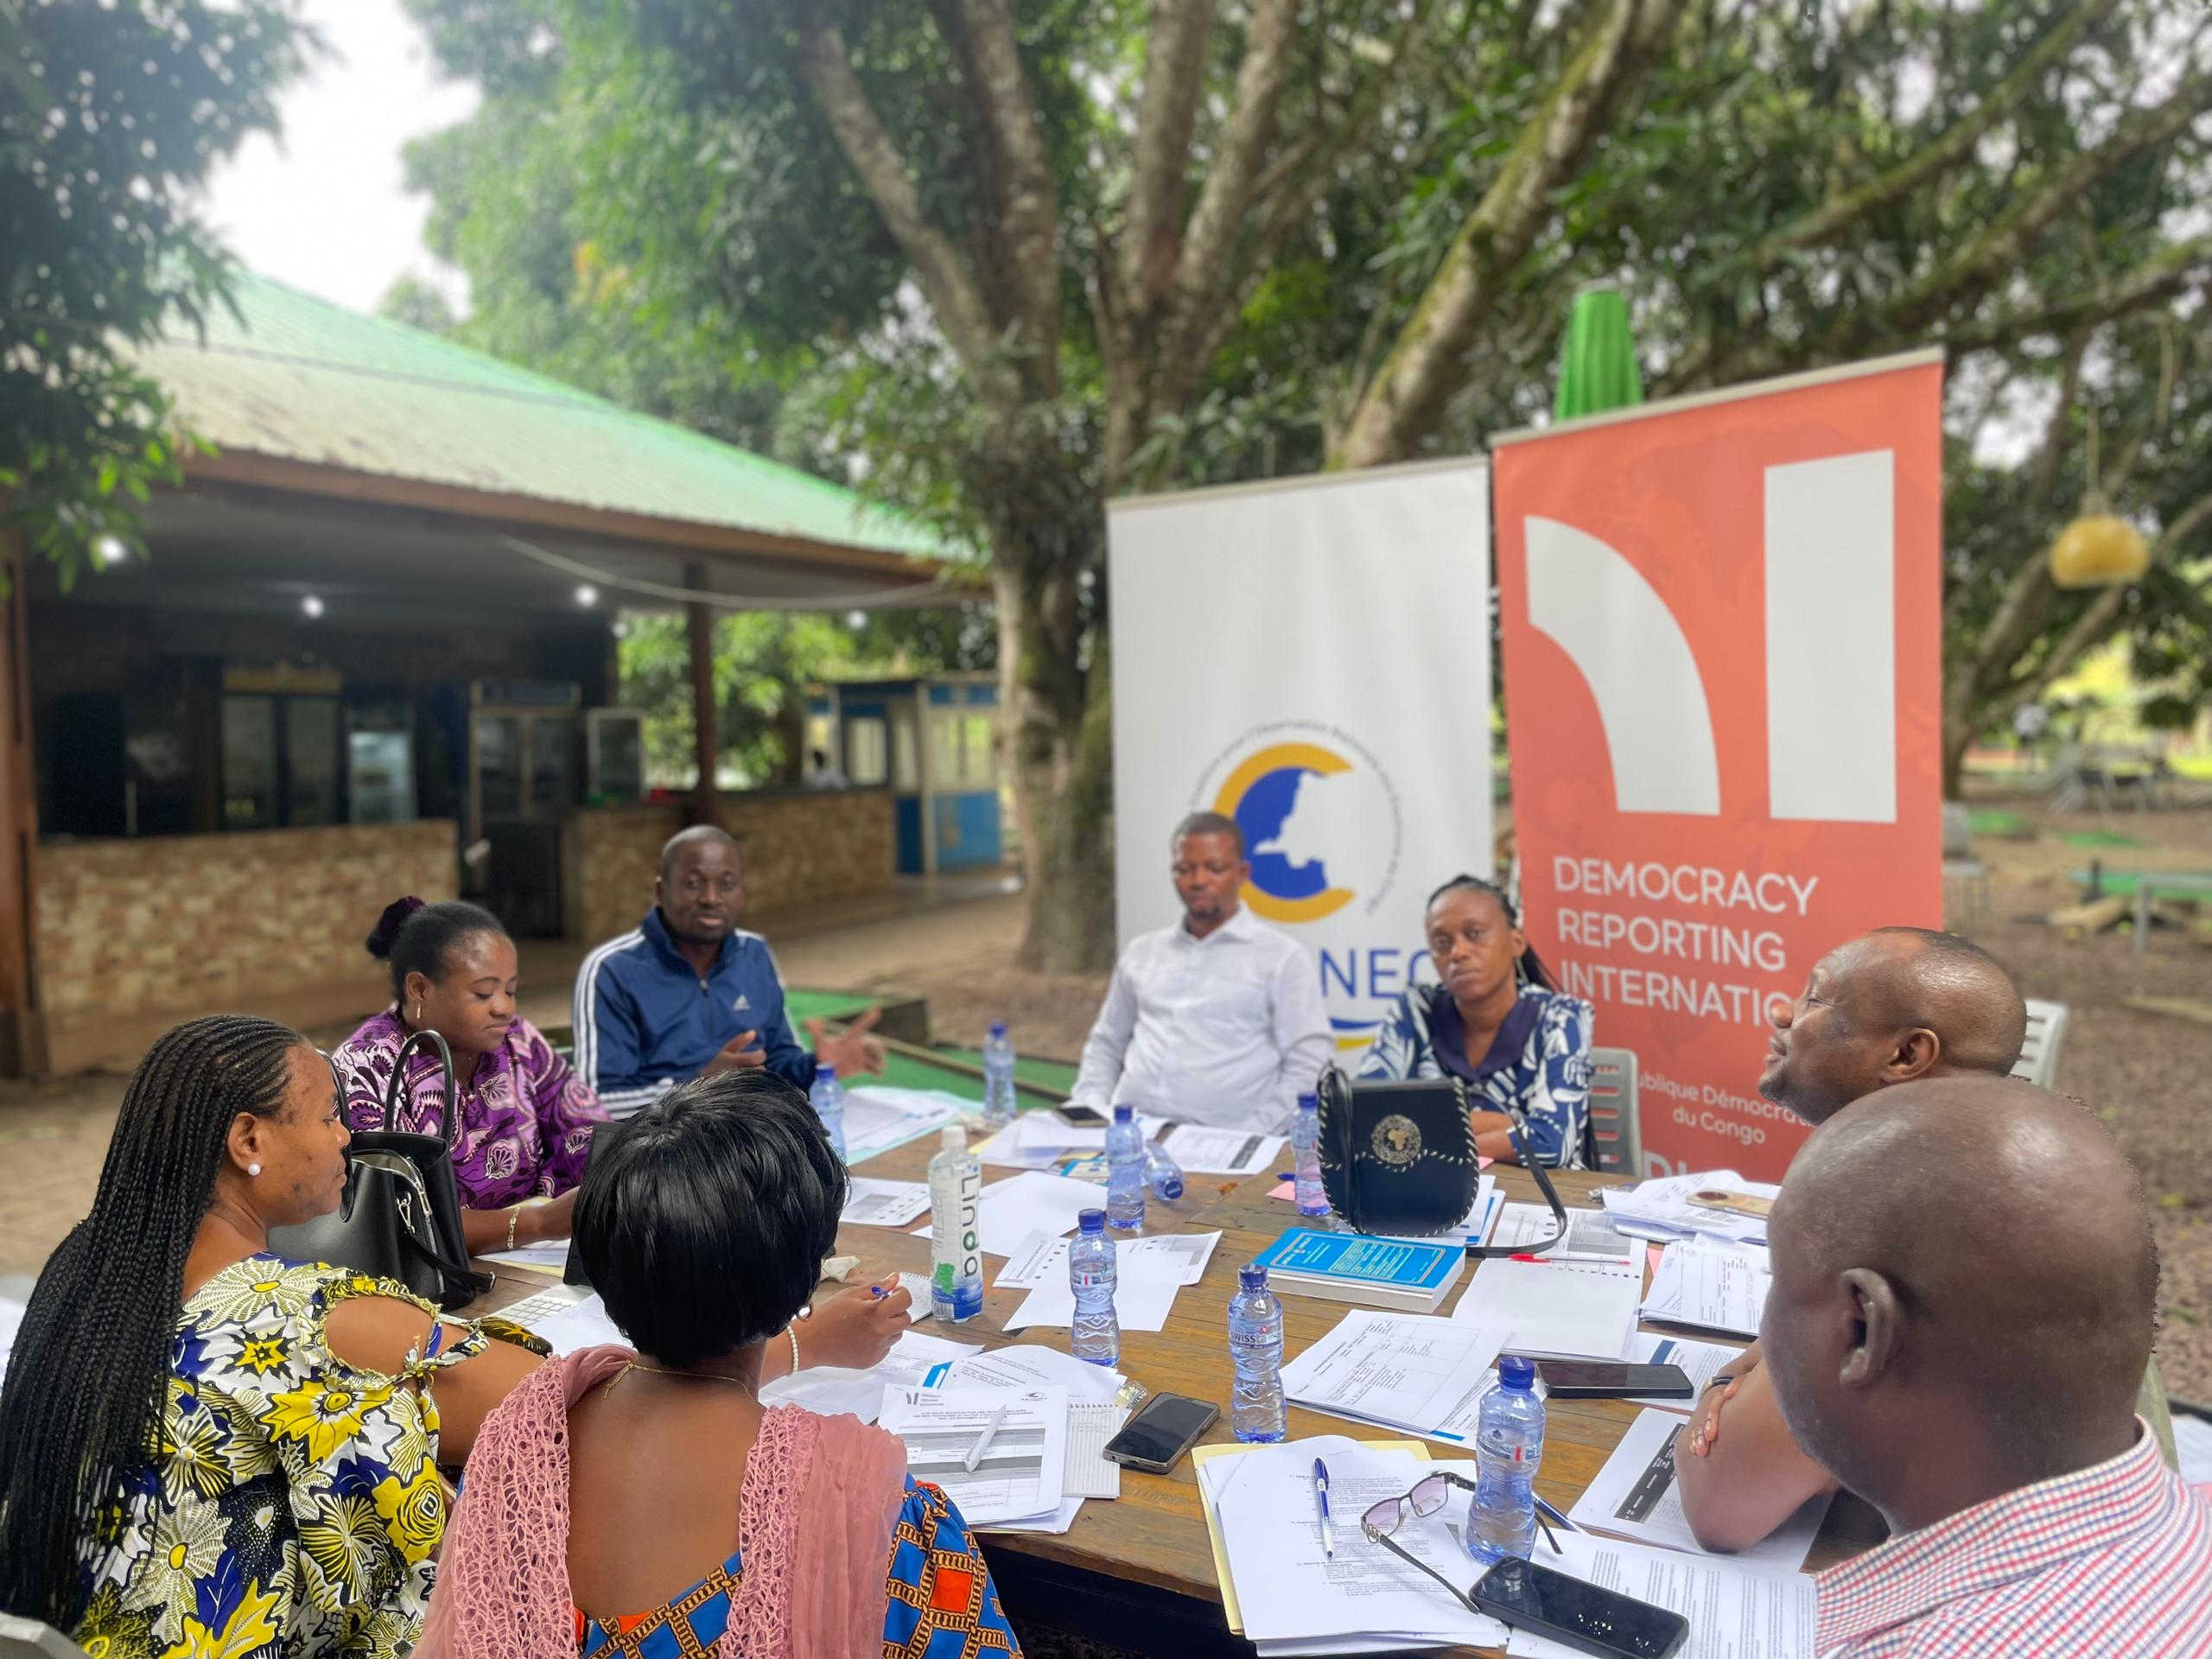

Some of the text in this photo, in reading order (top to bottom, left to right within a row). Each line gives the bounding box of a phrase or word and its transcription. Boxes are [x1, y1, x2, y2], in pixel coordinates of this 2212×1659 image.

[1554, 855, 1819, 917] DEMOCRACY
[1558, 907, 1787, 973] REPORTING
[1672, 1105, 1766, 1146] du Congo
